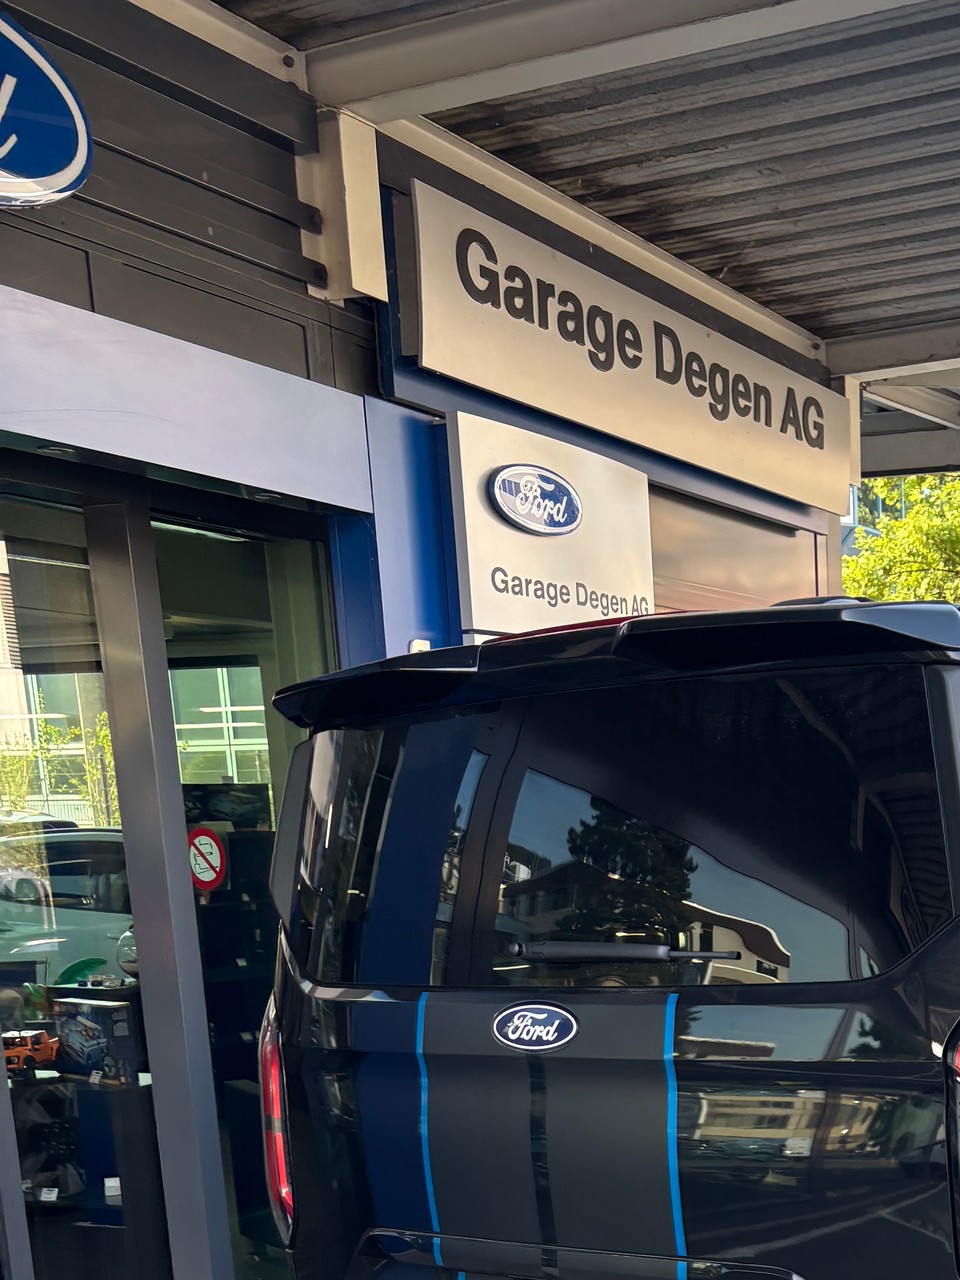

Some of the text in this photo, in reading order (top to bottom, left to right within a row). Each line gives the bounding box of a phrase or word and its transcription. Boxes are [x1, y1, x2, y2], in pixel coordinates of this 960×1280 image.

[456, 228, 824, 450] Garage Degen AG
[515, 475, 567, 524] Ford
[491, 567, 649, 616] Garage Degen AG
[507, 1011, 560, 1041] Ford
